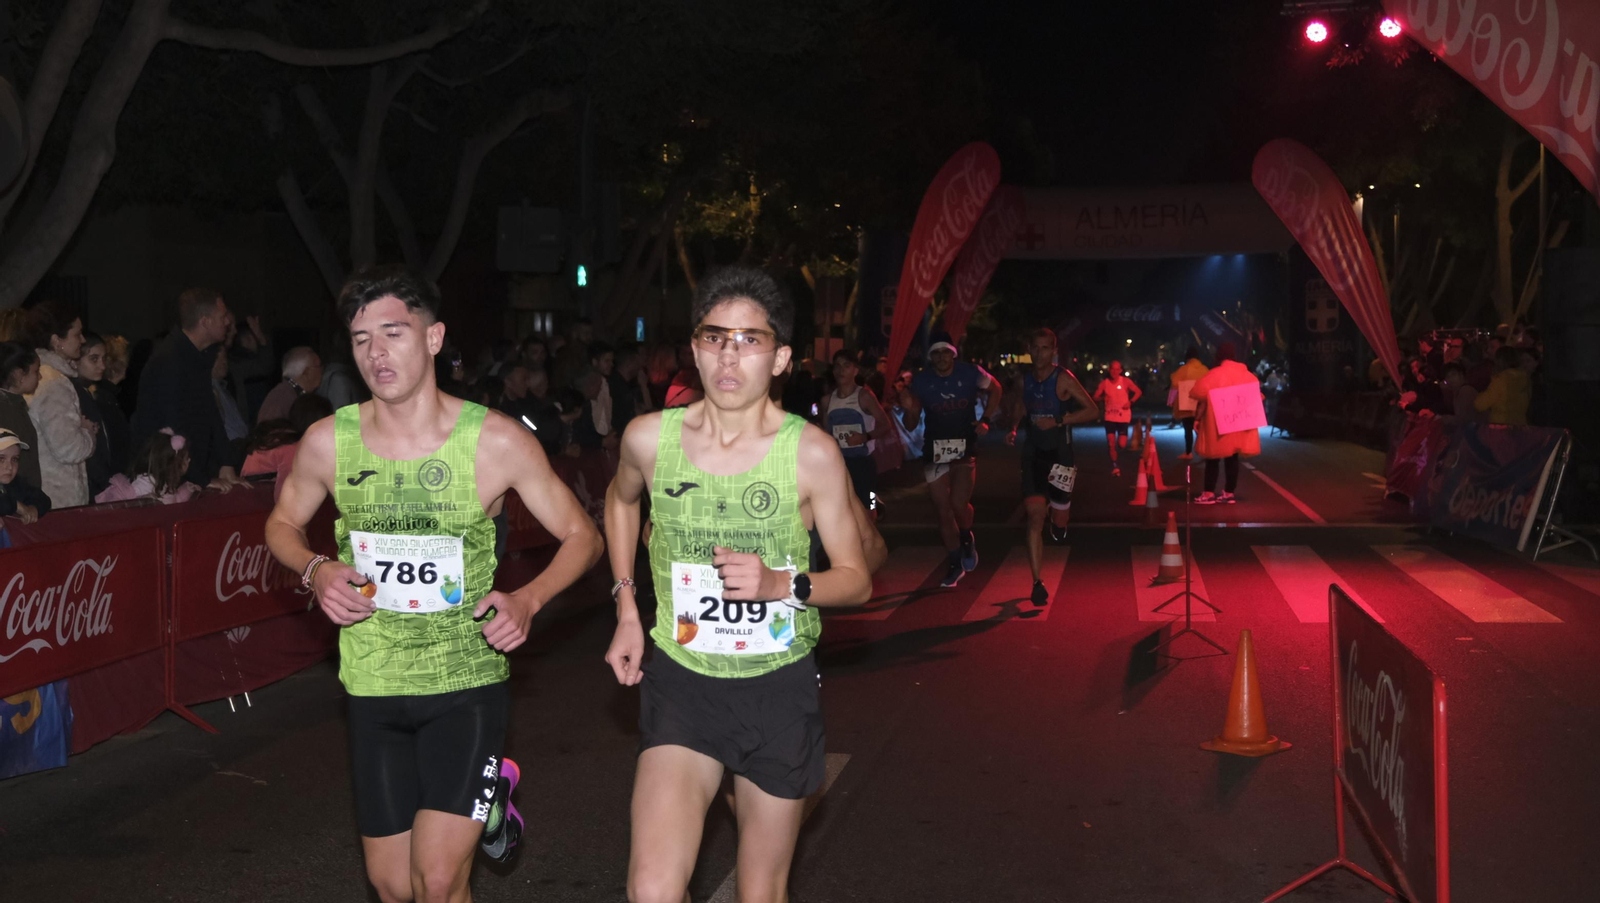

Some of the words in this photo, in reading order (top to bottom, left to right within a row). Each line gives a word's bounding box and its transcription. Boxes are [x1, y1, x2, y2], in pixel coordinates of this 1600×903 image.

[1075, 198, 1209, 230] ALMERÍA
[911, 150, 995, 298] Coca-Cola
[1074, 234, 1143, 249] CIUDAD
[1105, 304, 1163, 323] Coca-Cola
[941, 447, 958, 456] 754
[1057, 473, 1073, 484] 191
[362, 515, 438, 531] eCoCulture
[374, 538, 388, 547] XIV
[390, 538, 408, 547] SAN
[375, 546, 406, 557] CIUDAD
[408, 547, 418, 557] DE
[375, 561, 438, 585] 786
[700, 568, 715, 580] XIV
[700, 579, 724, 589] CIUD
[699, 596, 768, 624] 209
[1346, 640, 1407, 840] Coca-Cola
